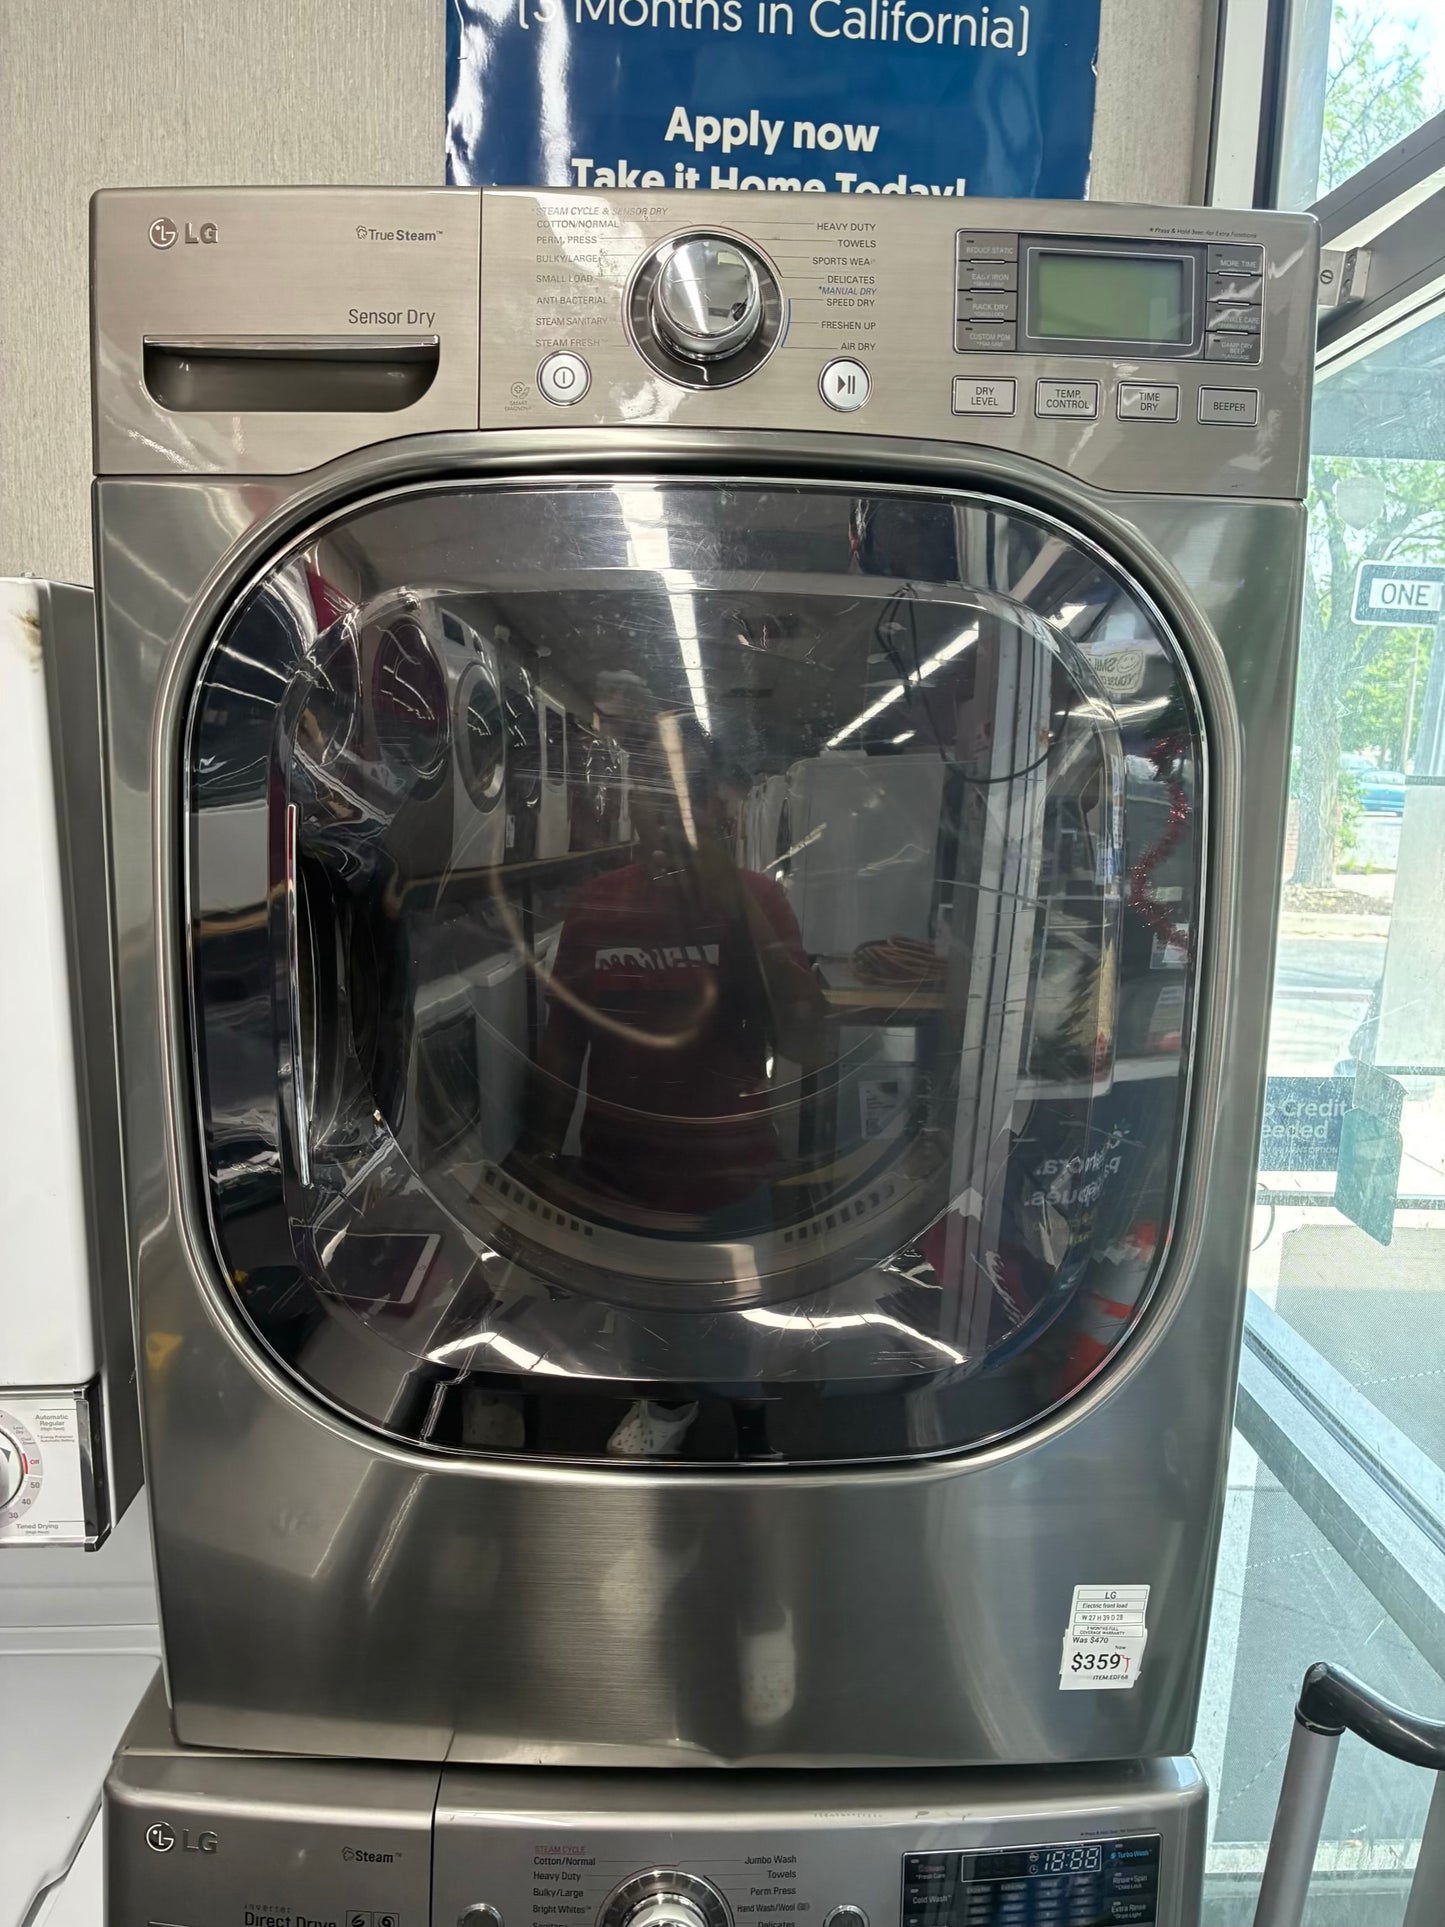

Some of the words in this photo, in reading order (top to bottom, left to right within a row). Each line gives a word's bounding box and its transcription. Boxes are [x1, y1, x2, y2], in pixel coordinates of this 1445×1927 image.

[575, 0, 742, 32] Months
[758, 2, 793, 35] in
[809, 0, 1030, 56] California)
[664, 106, 785, 156] Apply
[793, 121, 880, 152] now
[571, 158, 665, 188] Take
[674, 162, 700, 189] it
[570, 206, 599, 215] CYCLE
[649, 207, 668, 216] DRY
[536, 219, 620, 229] COTTON/NORMAL
[816, 222, 848, 231] HEAVY
[850, 223, 877, 232] DUTY
[184, 222, 219, 245] LG
[567, 235, 598, 244] PRESS
[838, 239, 877, 248] TOWELS
[536, 254, 600, 263] BULKY/LARGE
[812, 256, 848, 266] SPORTS
[849, 257, 876, 266] WEA
[1241, 260, 1257, 268] TIME
[536, 274, 566, 283] SMALL
[568, 274, 594, 283] LOAD
[827, 275, 875, 285] DELICATES
[859, 287, 877, 296] DRY
[536, 296, 559, 305] ANTI
[560, 296, 608, 305] BACTERIAL
[826, 298, 855, 307] SPEED
[857, 299, 875, 308] DRY
[972, 303, 993, 311] RACK
[348, 308, 403, 325] Sensor
[407, 308, 436, 329] Dry
[535, 317, 565, 326] STEAM
[566, 317, 608, 326] SANITARY
[821, 320, 862, 330] FRESHEN
[863, 321, 877, 330] UP
[535, 339, 568, 348] STEAM
[840, 342, 856, 351] AIR
[857, 342, 876, 351] DRY
[975, 386, 994, 396] DRY
[1055, 389, 1082, 399] TEMP.
[970, 396, 999, 407] LEVEL
[1139, 392, 1161, 402] TIME
[1046, 399, 1090, 410] CONTROL
[1140, 402, 1159, 412] DRY
[1213, 402, 1246, 413] BEEPER
[1381, 583, 1431, 606] ONE
[1280, 1098, 1347, 1117] Credit
[1262, 1120, 1329, 1139] eeded
[1105, 1591, 1117, 1600] LG
[1090, 1636, 1109, 1644] $470
[1071, 1652, 1121, 1672] $359
[182, 1828, 219, 1853] LG
[355, 1849, 394, 1864] Steam
[533, 1856, 596, 1866] Cotton/Normal
[744, 1855, 772, 1865] Jumbo
[773, 1854, 797, 1864] Wash
[1044, 1847, 1100, 1872] 18:88
[533, 1871, 560, 1882] Heavy
[561, 1871, 582, 1882] Duty
[767, 1869, 797, 1879] Towels
[533, 1887, 584, 1899] Bulky/Large
[750, 1887, 772, 1896] Perm
[773, 1886, 797, 1895] Press
[912, 1896, 928, 1904] Cold
[532, 1904, 557, 1915] Bright
[737, 1904, 755, 1913] Hand
[755, 1903, 796, 1913] Wash/Wool
[1111, 1905, 1128, 1913] Extra
[1129, 1904, 1147, 1913] Rinse
[244, 1911, 291, 1927] Direct
